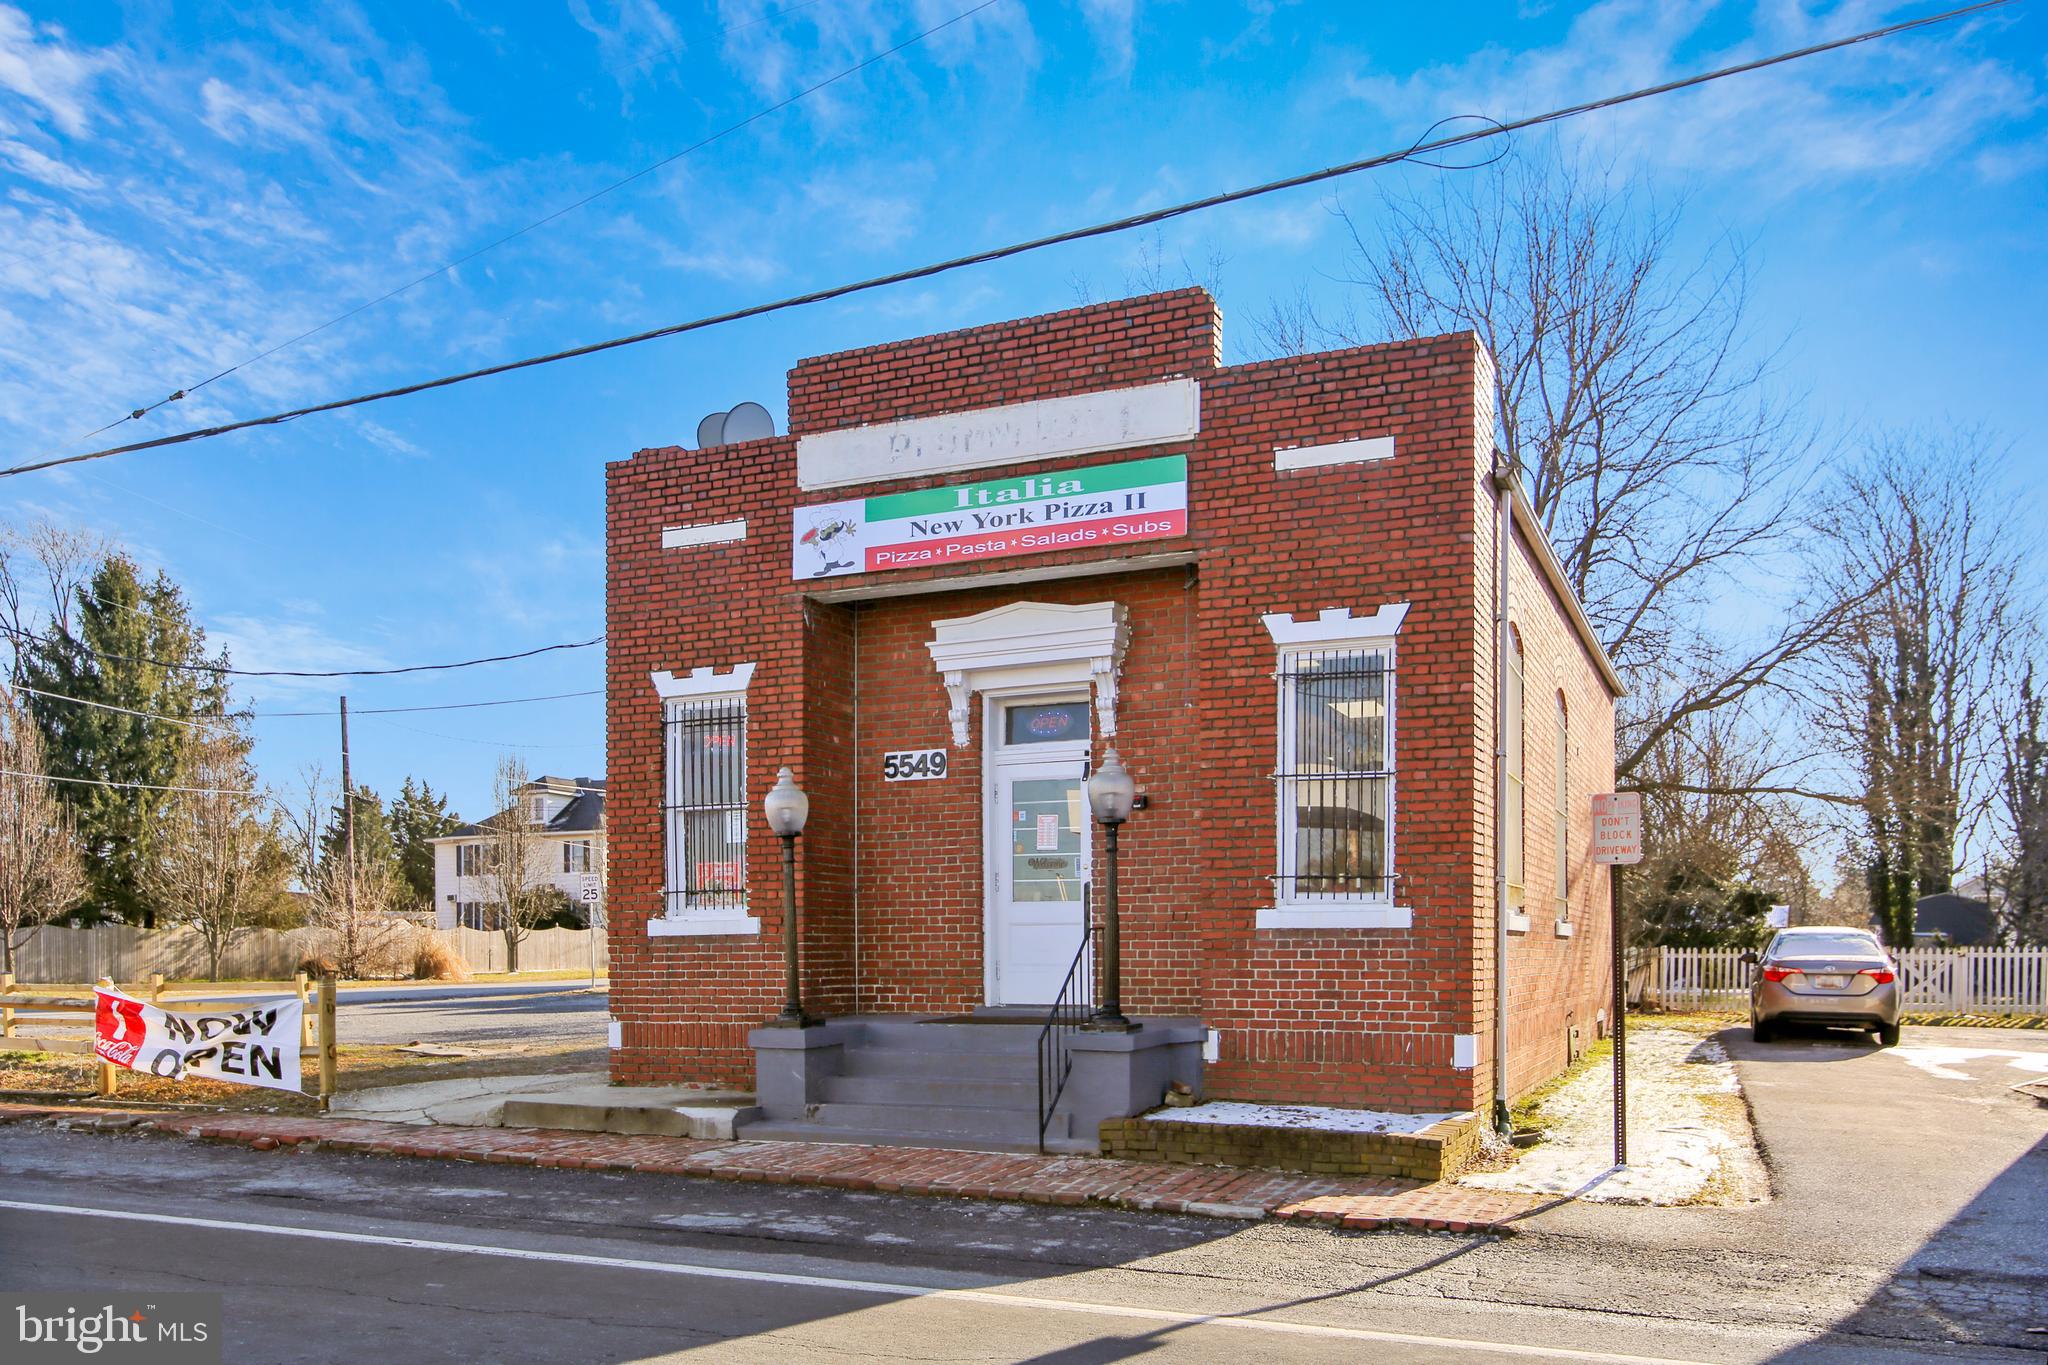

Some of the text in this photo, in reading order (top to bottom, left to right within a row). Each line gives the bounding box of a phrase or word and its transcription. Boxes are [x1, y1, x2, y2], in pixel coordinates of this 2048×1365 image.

[953, 478, 1084, 508] Italia
[910, 492, 1147, 537] New York Pizza II
[876, 520, 1172, 565] Pizza Pasta Salads Subs
[1031, 714, 1068, 729] OPEN
[884, 752, 946, 779] 5549
[1600, 830, 1632, 840] BLOCK
[1601, 816, 1630, 827] DON'T
[1596, 844, 1638, 856] DRIVEWAY
[582, 889, 598, 900] 25
[164, 1008, 277, 1044] NOW
[151, 1041, 282, 1079] OPEN
